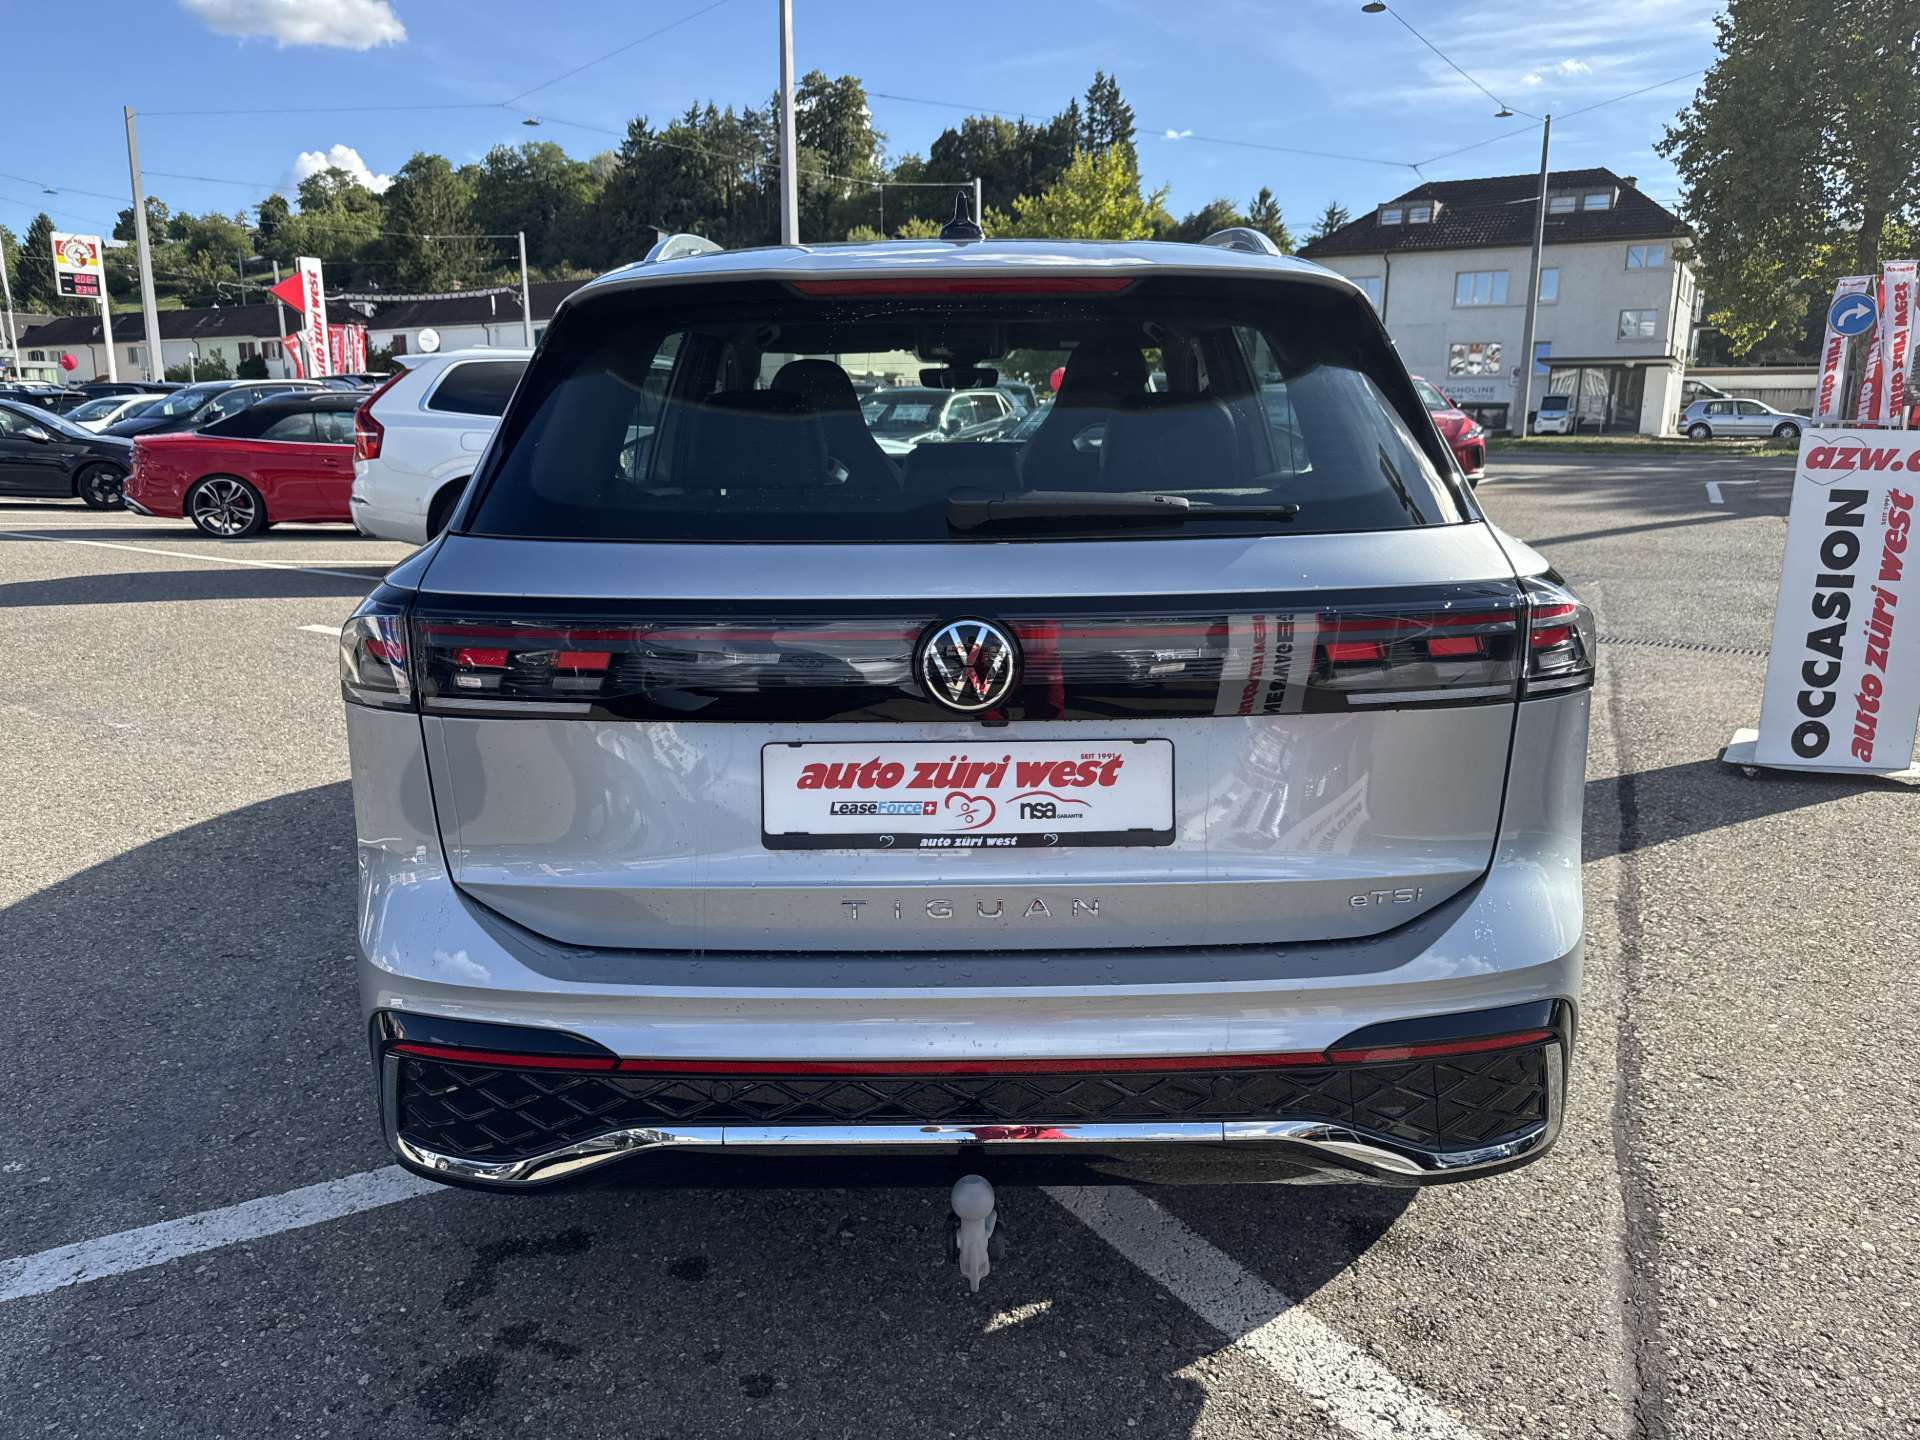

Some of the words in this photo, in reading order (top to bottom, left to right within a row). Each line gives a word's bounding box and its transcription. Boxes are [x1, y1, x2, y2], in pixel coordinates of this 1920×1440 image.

[315, 347, 327, 377] uto
[1878, 488, 1915, 581] west
[1790, 489, 1869, 759] OCCASION
[1863, 585, 1898, 674] züri
[1851, 672, 1883, 764] auto
[1098, 752, 1116, 760] 1991
[797, 756, 905, 790] auto
[905, 754, 1012, 789] züri
[1016, 754, 1125, 788] west
[1020, 802, 1057, 820] nsa
[919, 837, 951, 847] auto
[953, 835, 984, 847] züri
[986, 835, 1018, 846] west
[841, 898, 1101, 920] TIGUAN
[1348, 887, 1424, 907] eTSi
